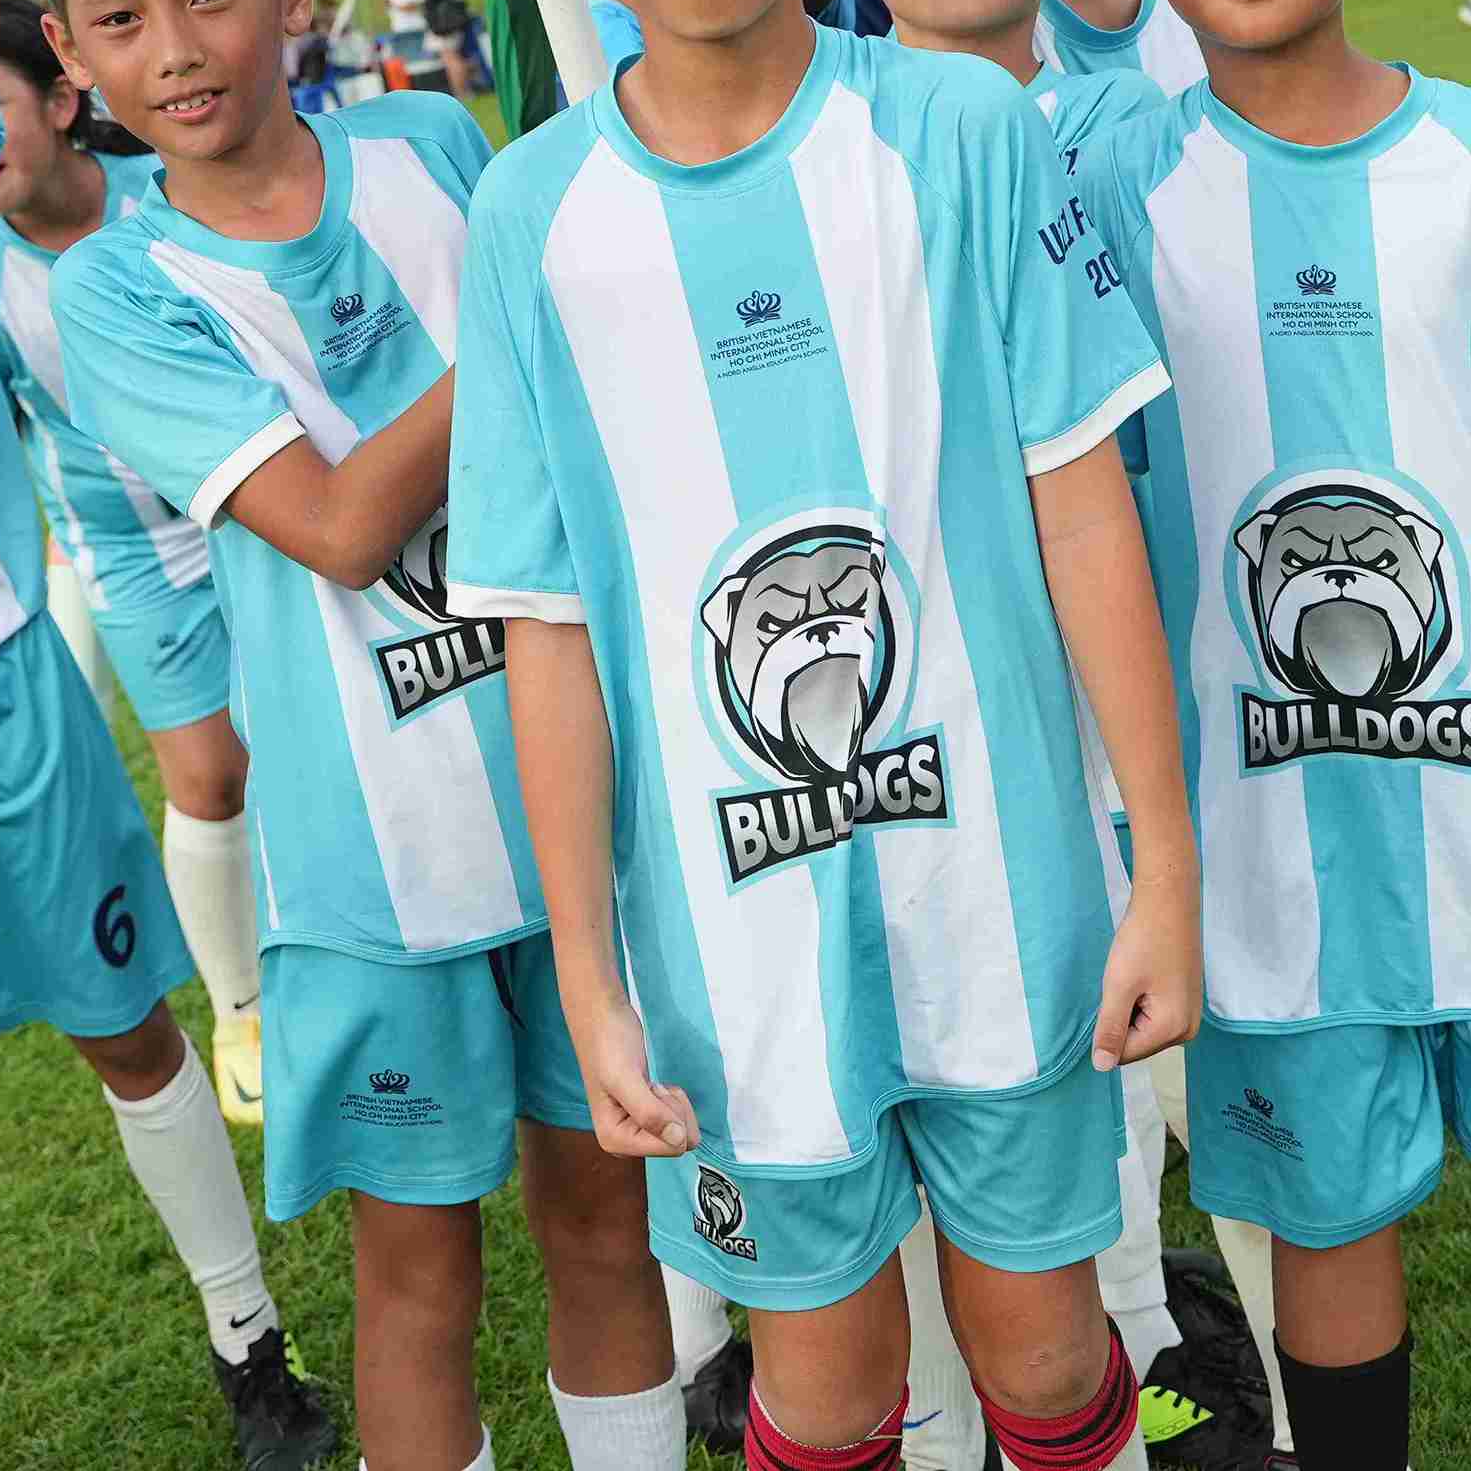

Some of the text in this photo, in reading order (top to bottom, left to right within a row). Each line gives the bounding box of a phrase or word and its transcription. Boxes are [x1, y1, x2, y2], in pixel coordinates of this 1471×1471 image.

[1266, 310, 1374, 320] INTERNATIONAL SCHOOL
[1306, 301, 1363, 310] VIETNAMESE
[716, 317, 812, 349] BRITISH VIETNAMESE
[1297, 320, 1313, 328] CHI
[1313, 320, 1337, 328] MINH
[1338, 320, 1359, 328] CITY
[710, 326, 825, 361] INTERNATIONAL SCHOOL
[729, 339, 811, 368] HO CHI MINH CITY
[94, 884, 136, 968] 6
